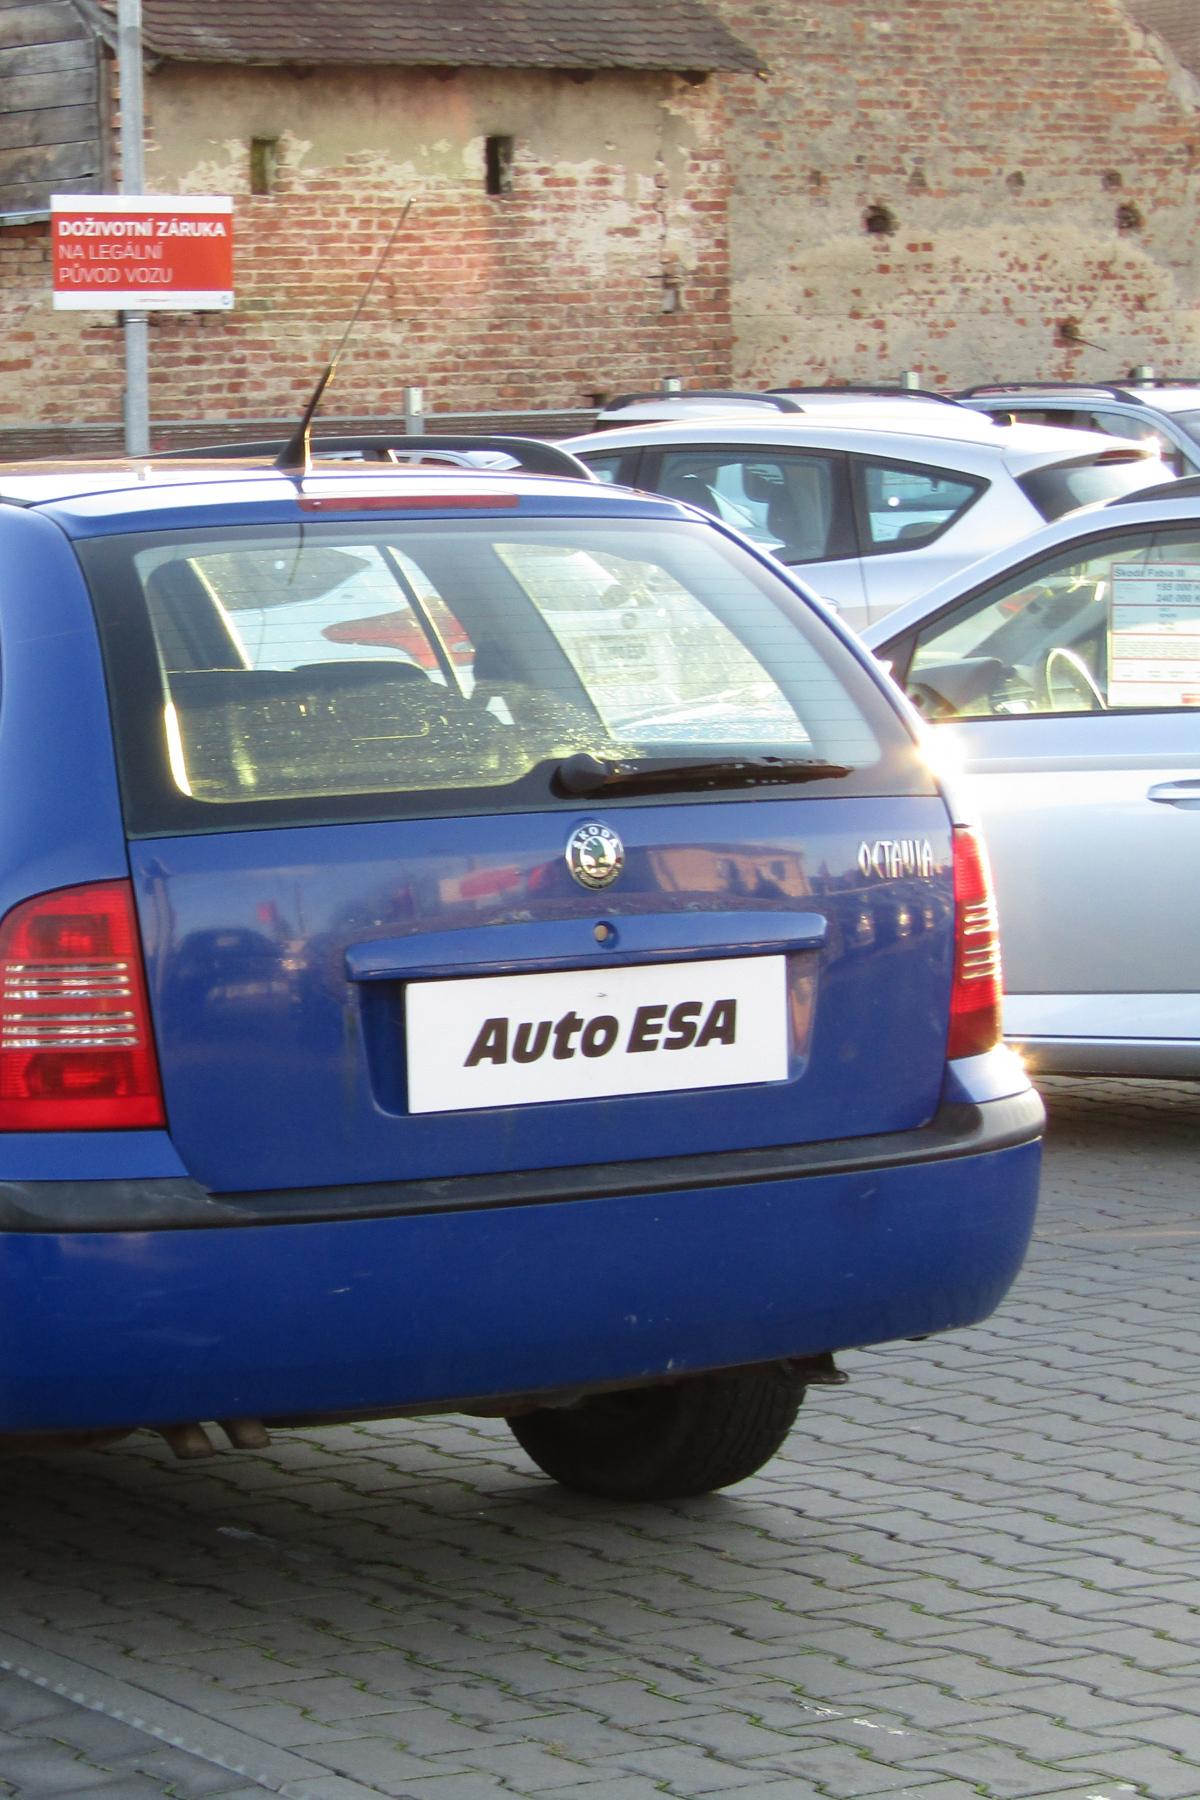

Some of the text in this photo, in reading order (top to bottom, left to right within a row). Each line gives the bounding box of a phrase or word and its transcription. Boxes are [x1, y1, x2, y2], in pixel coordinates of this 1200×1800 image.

[58, 217, 227, 237] DOŽIVOTNÍ ZÁRUKA
[58, 241, 163, 260] NA LEGÁLNÍ
[59, 264, 173, 283] PŮVOD VOZU
[857, 839, 934, 879] OCTAVIA
[463, 998, 737, 1067] Auto ESA
